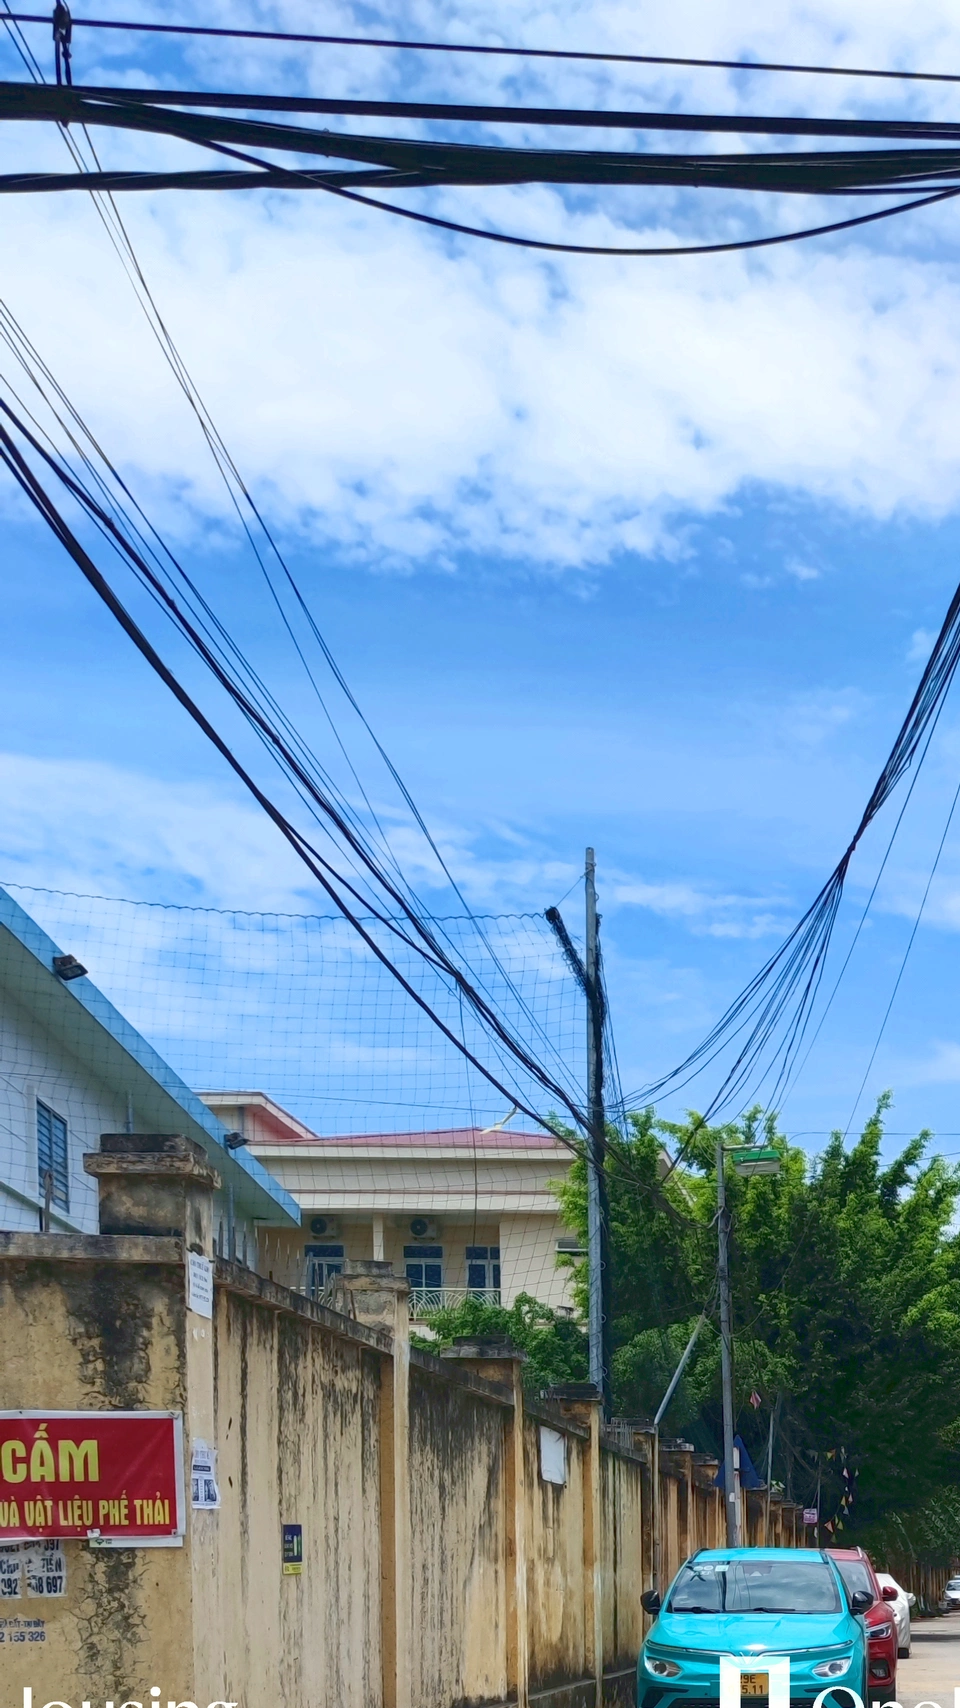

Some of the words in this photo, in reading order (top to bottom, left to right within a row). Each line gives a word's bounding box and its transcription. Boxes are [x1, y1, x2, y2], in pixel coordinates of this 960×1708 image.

[1, 1423, 99, 1483] CẤM
[24, 1495, 53, 1532] VẬT
[59, 1495, 93, 1531] LIỆU
[99, 1490, 129, 1525] PHẾ
[134, 1491, 170, 1525] THẢI
[46, 1575, 63, 1593] 697
[28, 1631, 46, 1642] 326
